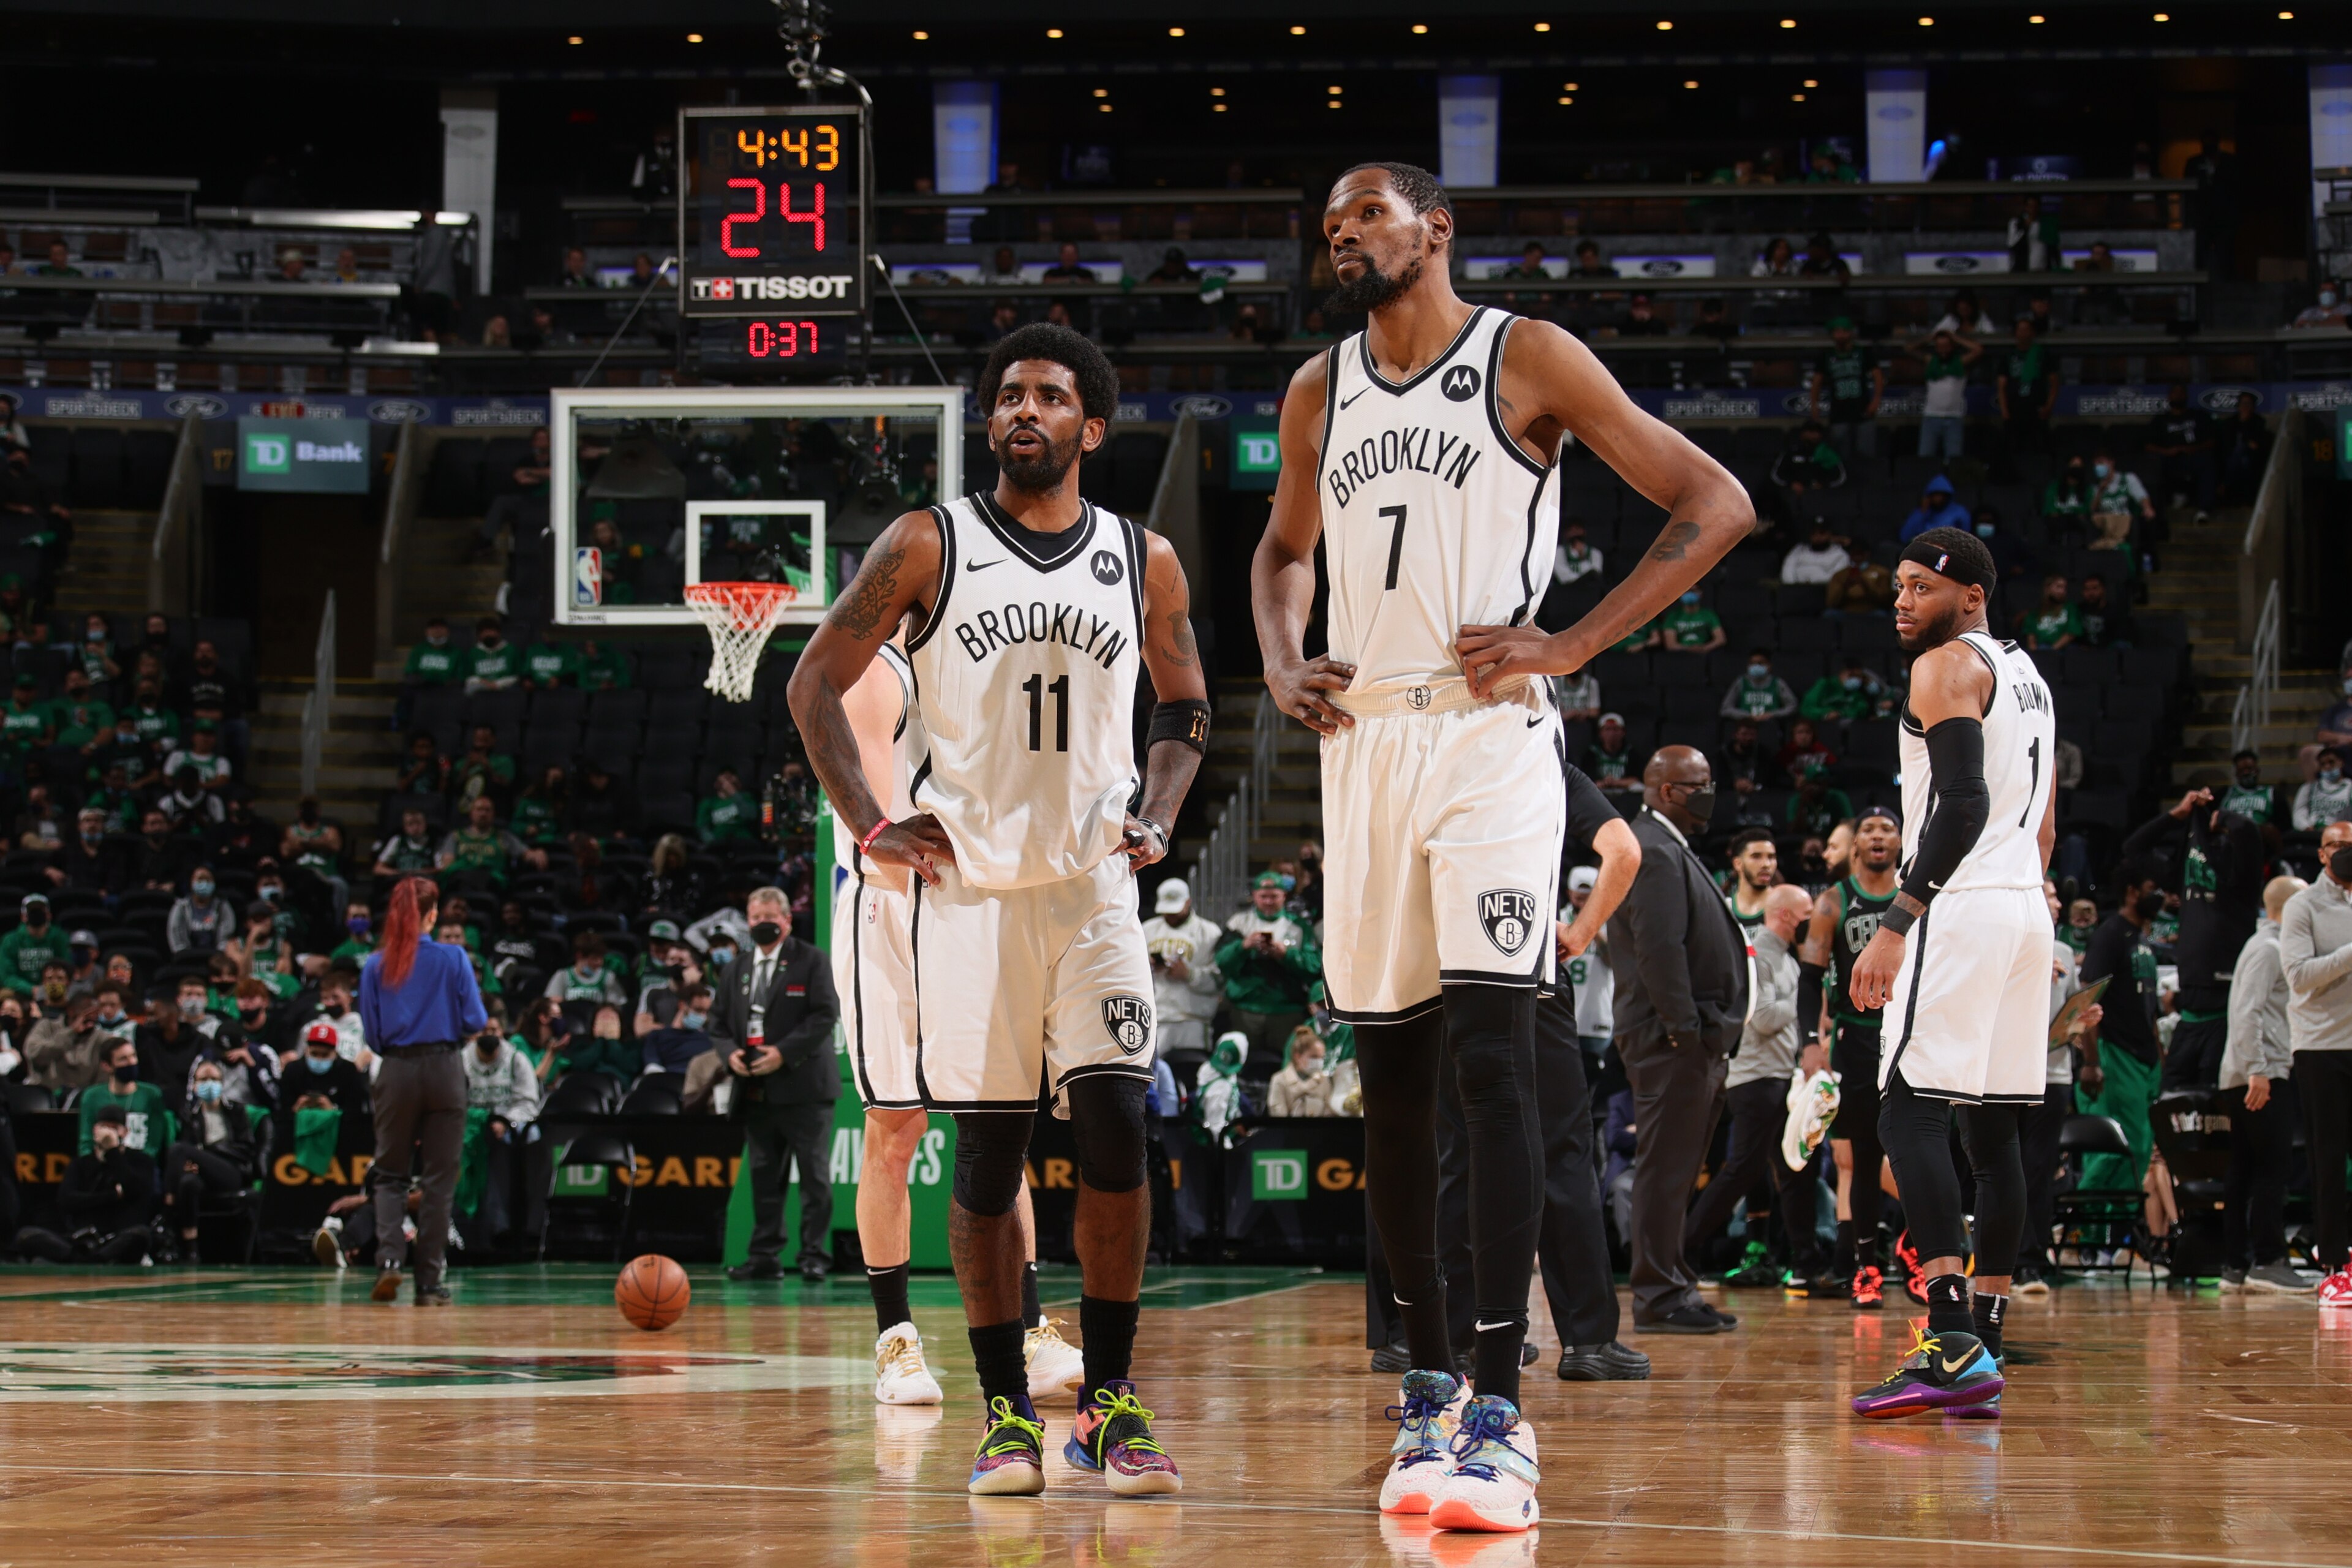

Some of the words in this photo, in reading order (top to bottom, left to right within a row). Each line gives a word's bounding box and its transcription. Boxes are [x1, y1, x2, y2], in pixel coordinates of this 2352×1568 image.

[737, 124, 839, 171] 4:43
[721, 178, 825, 257] 24
[735, 275, 853, 300] TISSOT
[748, 322, 818, 357] 0:37
[249, 440, 287, 466] TD
[295, 441, 363, 462] Bank
[1239, 438, 1278, 464] TD
[1329, 427, 1481, 510] BROOKLYN
[1379, 504, 1407, 590] 7
[955, 601, 1128, 669] BROOKLYN
[1022, 673, 1069, 752] 11
[2018, 736, 2040, 829] 1
[1484, 892, 1534, 922] NETS
[1506, 922, 1515, 944] B
[1107, 998, 1150, 1028] NETS
[1128, 1024, 1136, 1045] B
[616, 1155, 742, 1188] GAR
[1257, 1159, 1302, 1188] TD
